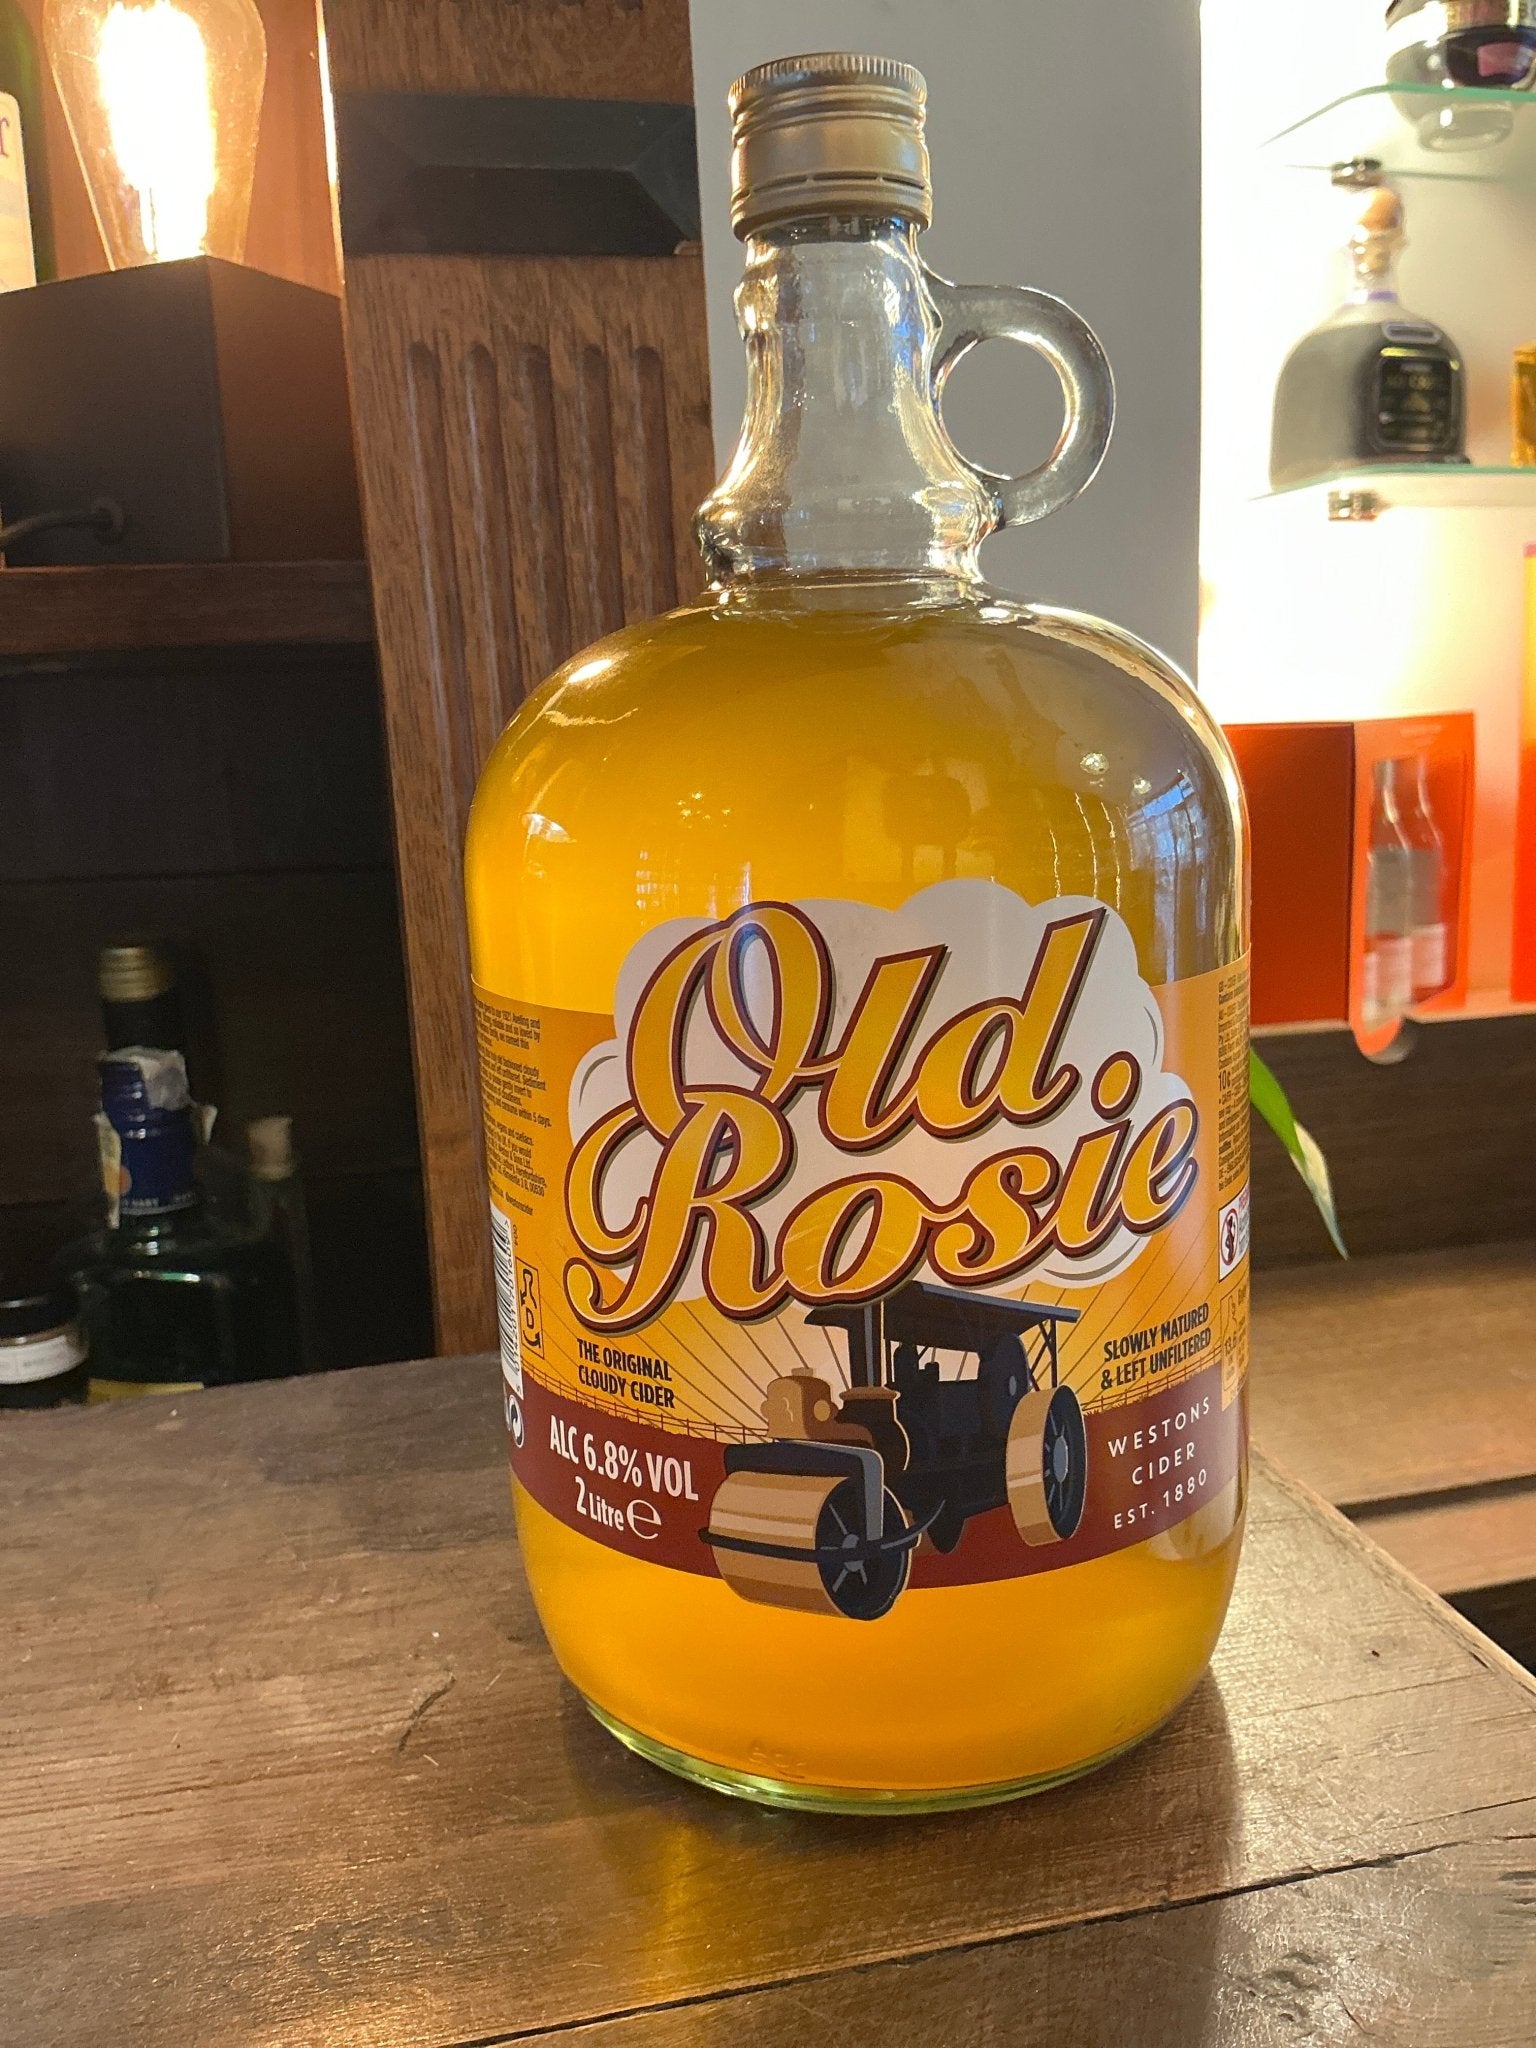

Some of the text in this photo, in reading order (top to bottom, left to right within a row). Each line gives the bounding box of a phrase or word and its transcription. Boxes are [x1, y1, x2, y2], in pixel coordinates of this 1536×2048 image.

[530, 1018, 540, 1029] and
[534, 1030, 540, 1043] by
[626, 900, 1107, 1152] Old
[533, 1112, 537, 1123] 5
[537, 1114, 552, 1127] days.
[563, 1050, 1199, 1333] Rosie
[577, 1338, 672, 1382] THE ORIGINAL
[1100, 1369, 1113, 1391] &
[1116, 1357, 1147, 1386] LEFT
[1149, 1327, 1212, 1375] UNFILTERED
[1104, 1302, 1210, 1363] SLOWLY MATURED
[578, 1364, 675, 1409] CLOUDY CIDER
[1108, 1396, 1211, 1458] WESTONS
[550, 1414, 699, 1501] ALC 6.8% VOL
[1131, 1441, 1195, 1486] CIDER
[575, 1476, 587, 1516] 2
[589, 1492, 625, 1531] Litre
[1113, 1468, 1208, 1530] EST. 1880
